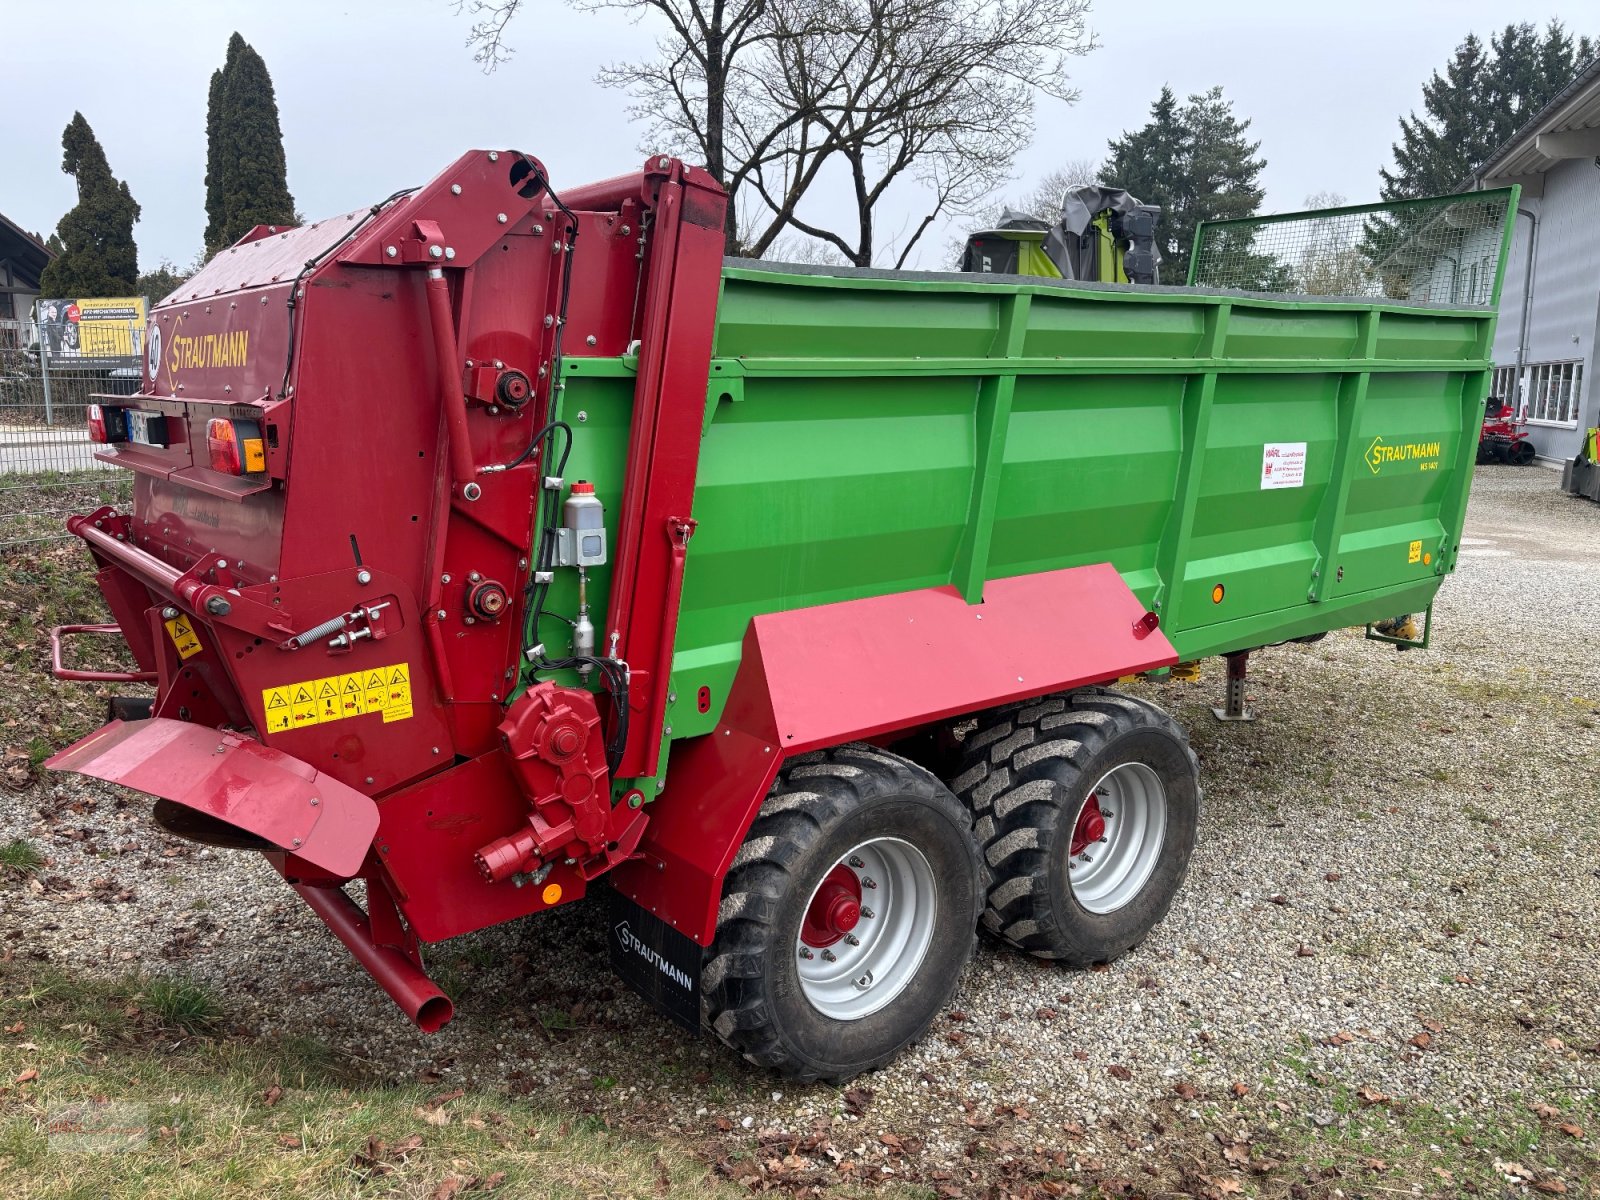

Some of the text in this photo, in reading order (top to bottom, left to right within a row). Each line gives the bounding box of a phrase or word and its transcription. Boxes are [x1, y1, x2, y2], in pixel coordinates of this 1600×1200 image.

[150, 334, 158, 370] 40
[171, 330, 248, 372] STRAUTMANN
[1373, 441, 1440, 465] STRAUTMANN
[621, 927, 692, 992] STRAUTMANN
